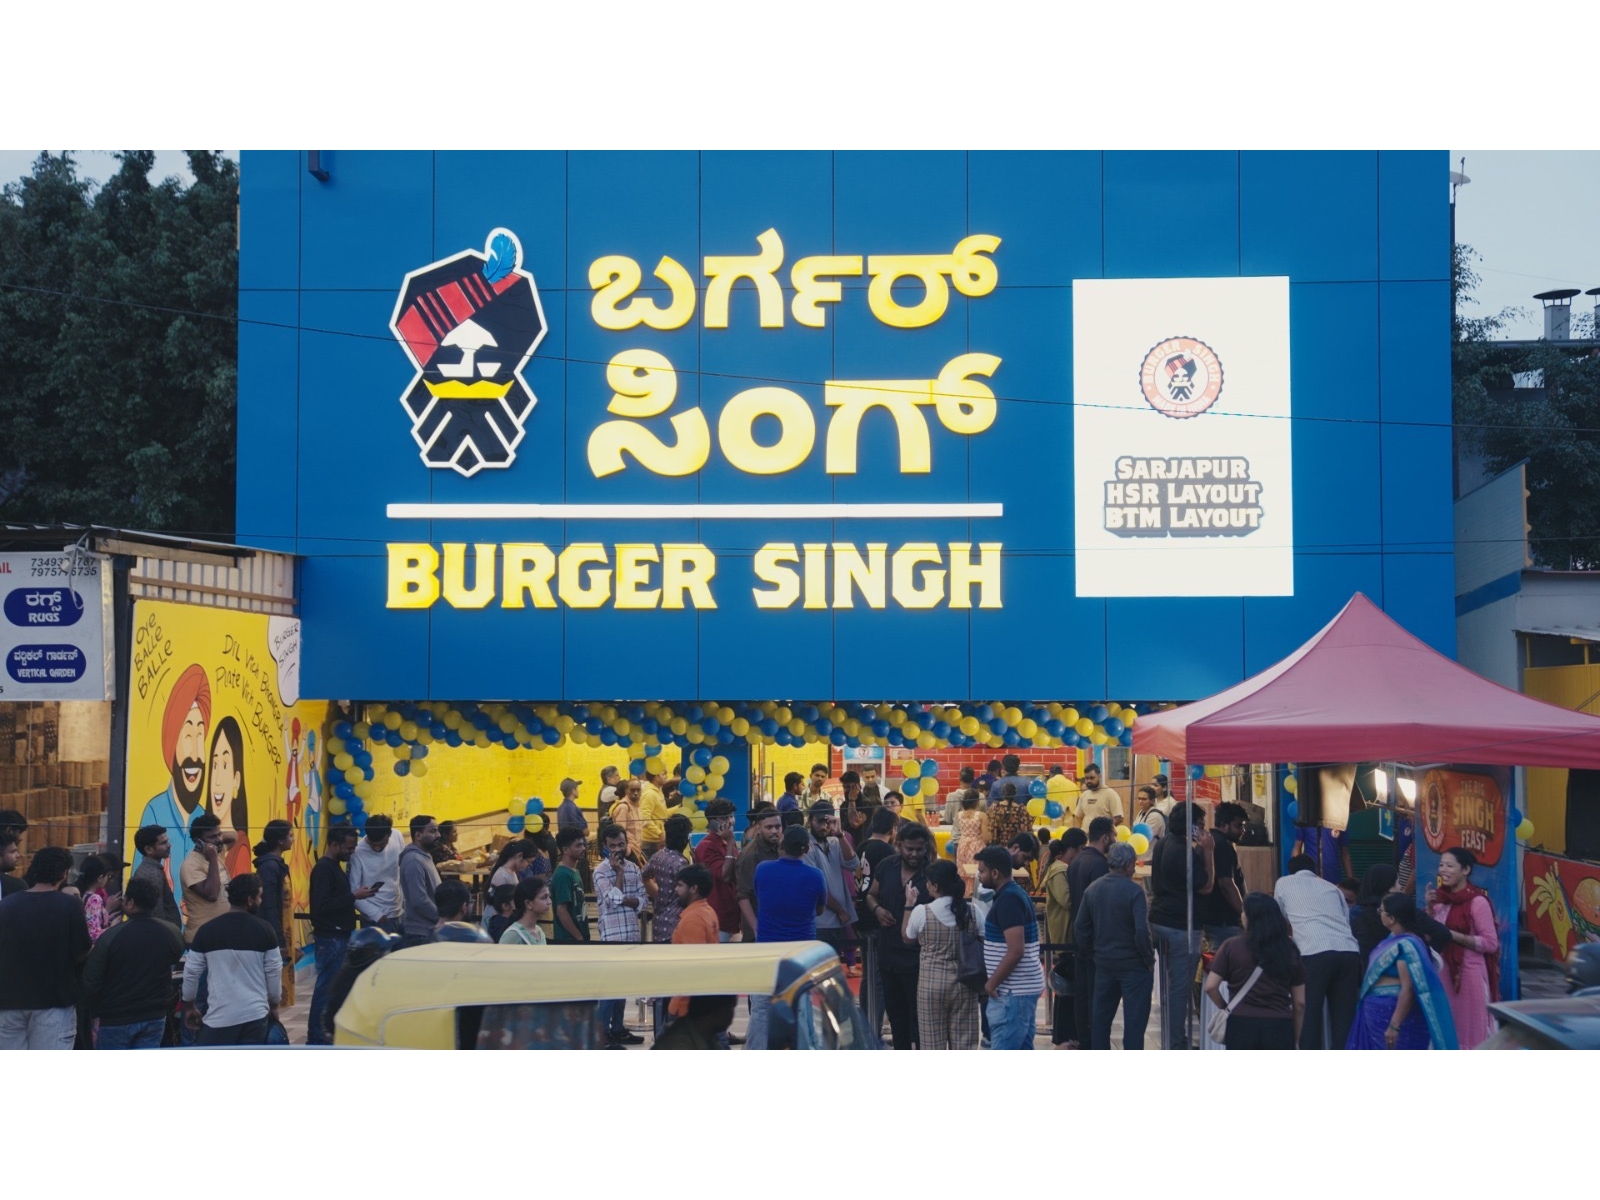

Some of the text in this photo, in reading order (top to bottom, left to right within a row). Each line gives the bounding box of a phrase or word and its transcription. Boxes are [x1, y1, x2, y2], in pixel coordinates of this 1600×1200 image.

[1142, 340, 1220, 384] BURGER SINGH
[587, 348, 1002, 478] ಸಿಂಗ್
[1117, 457, 1248, 480] SARJAPUR
[1106, 483, 1261, 505] HSR LAYOUT
[1105, 506, 1263, 529] BTM LAYOUT
[31, 567, 97, 577] 797576735
[386, 542, 1004, 609] BURGER SINGH
[28, 612, 60, 623] RUGS
[17, 668, 76, 678] VERTICAL GARDEN
[1452, 795, 1495, 835] SINGH
[1461, 829, 1486, 854] FEAST
